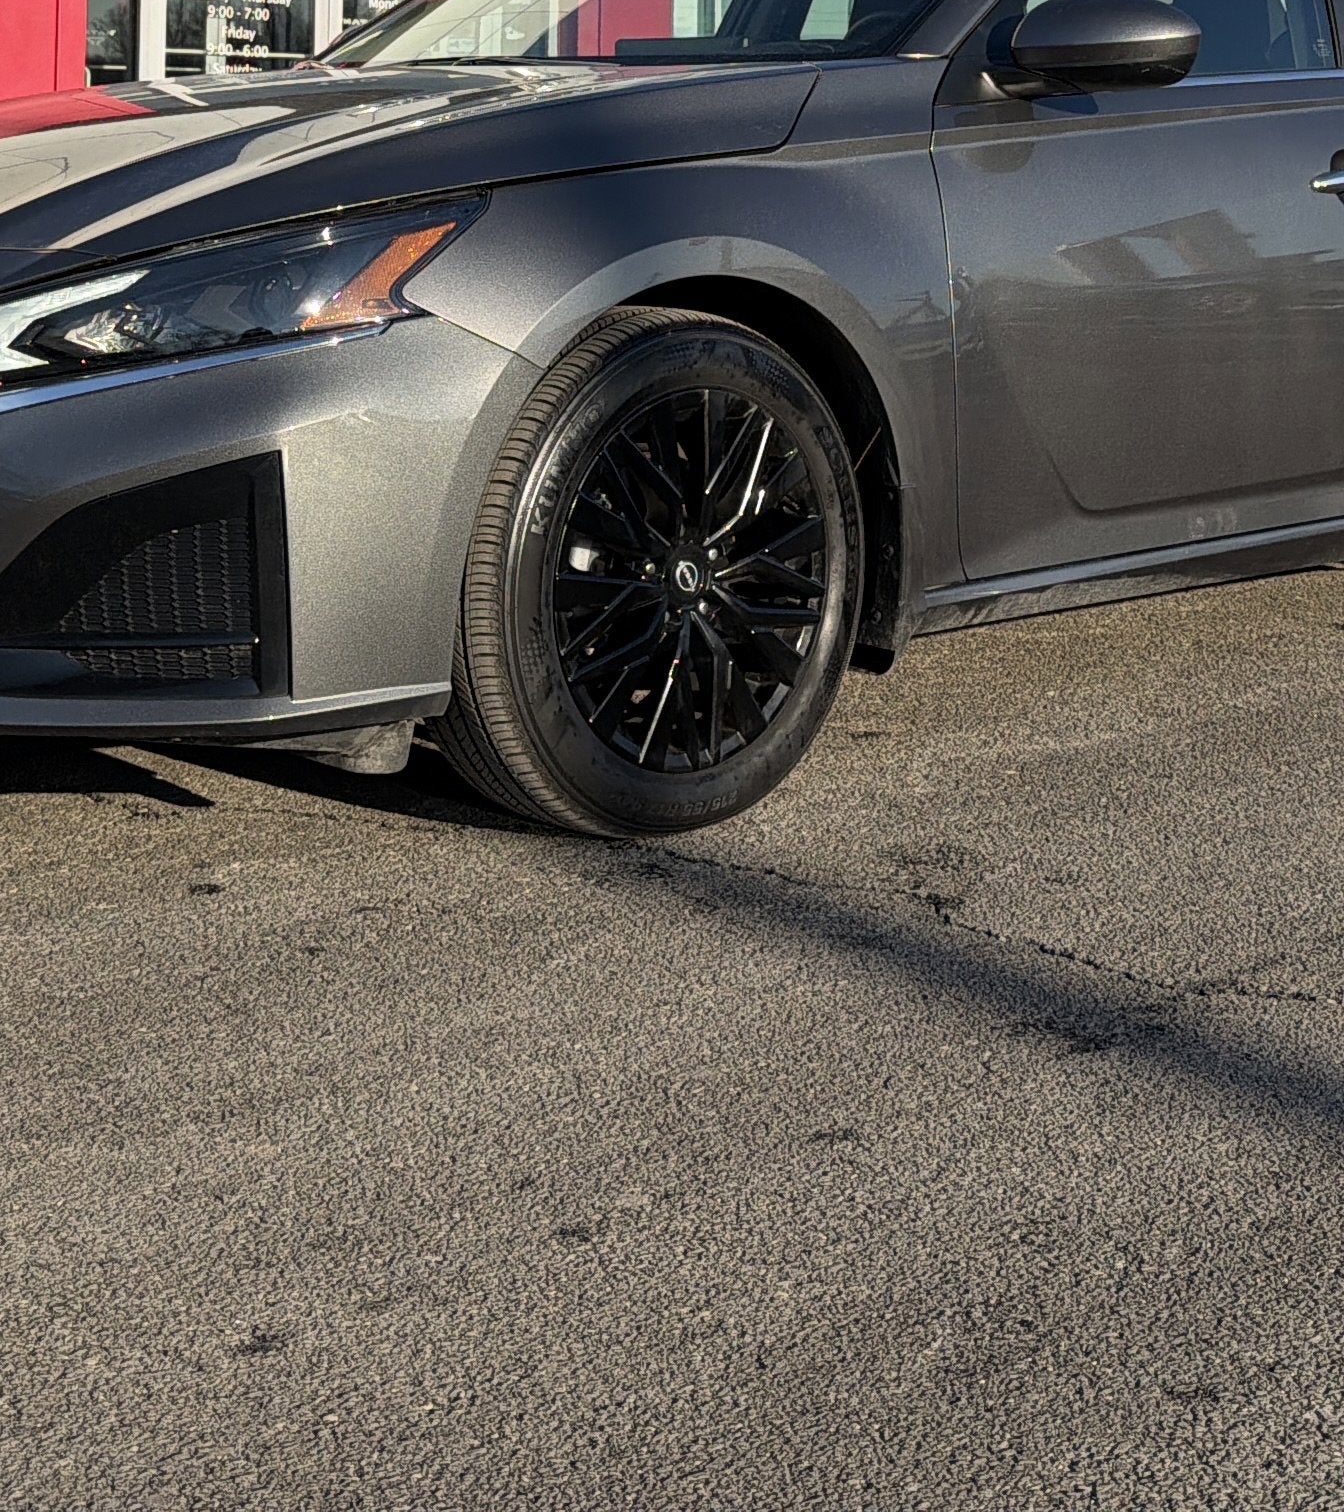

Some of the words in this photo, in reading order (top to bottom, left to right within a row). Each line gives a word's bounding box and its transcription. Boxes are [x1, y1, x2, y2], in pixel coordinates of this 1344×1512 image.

[207, 5, 234, 19] 9:00
[244, 7, 270, 21] 7:00
[221, 25, 256, 42] Friday
[243, 43, 269, 58] 6:00
